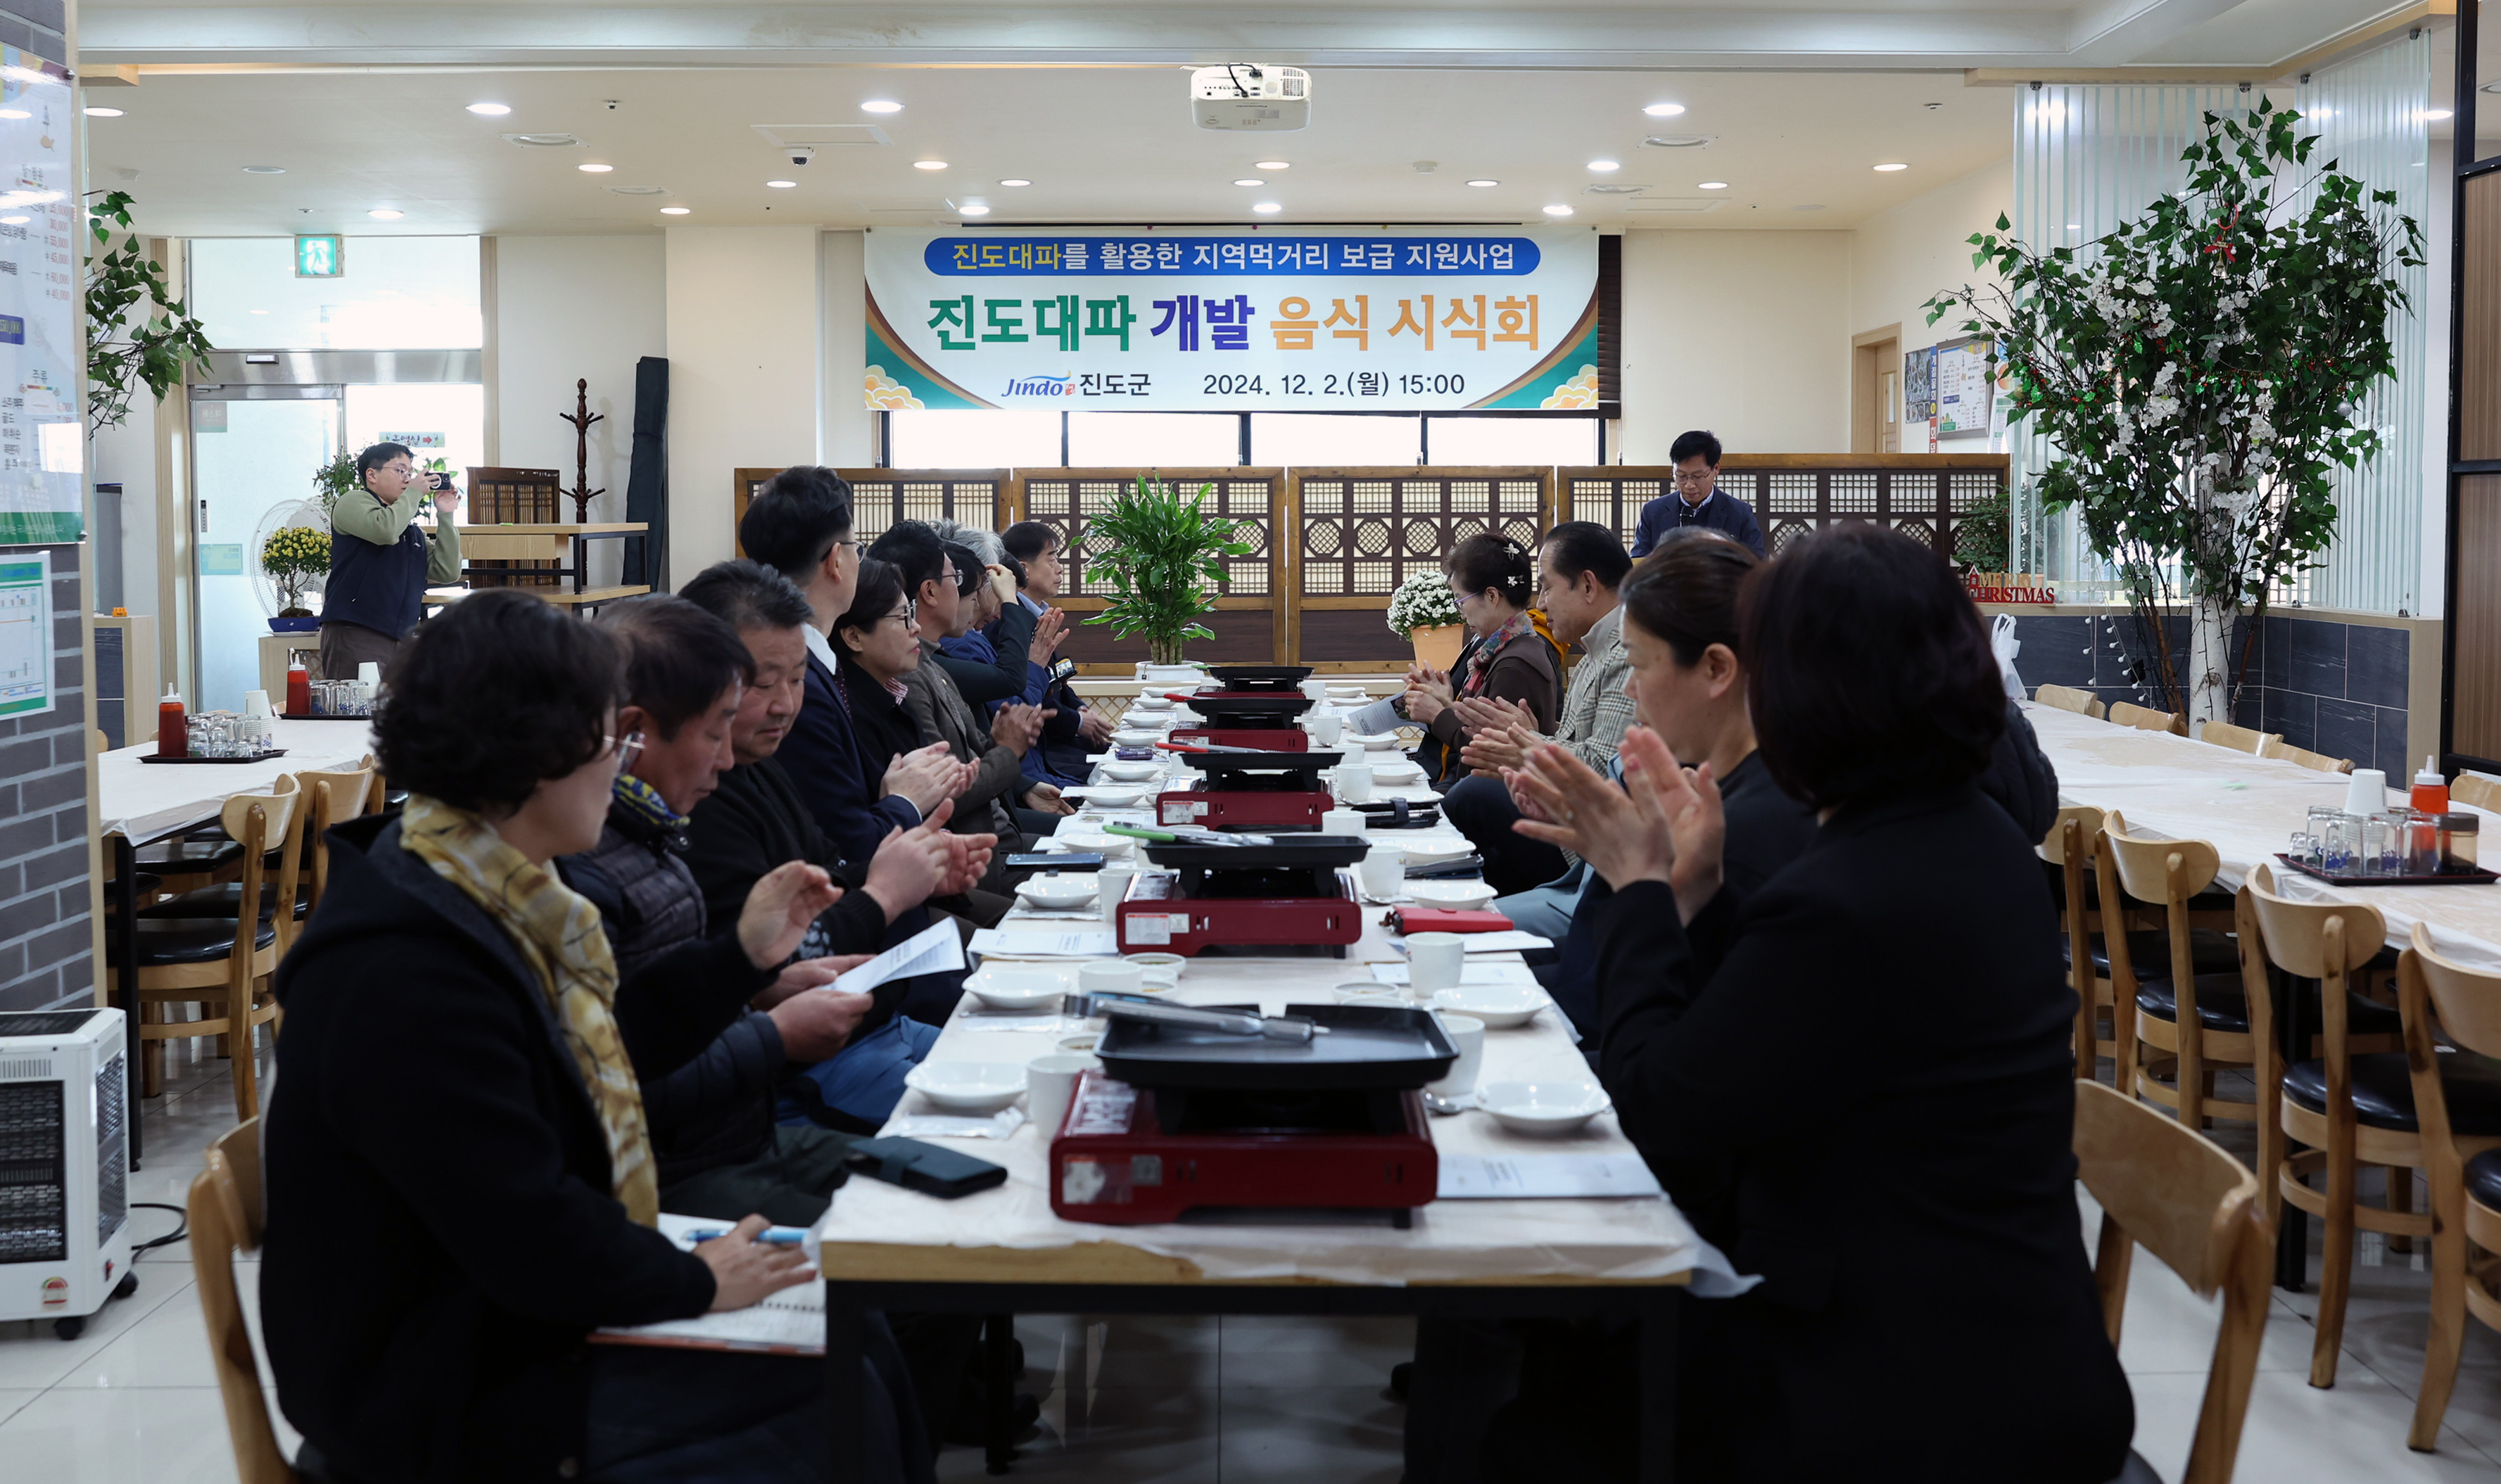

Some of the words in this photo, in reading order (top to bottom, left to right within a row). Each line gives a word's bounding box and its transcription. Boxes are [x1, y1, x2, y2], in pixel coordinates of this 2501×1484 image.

[953, 243, 1089, 270] 진도대파를
[1099, 243, 1183, 270] 활용한
[1193, 243, 1329, 270] 지역먹거리
[1340, 243, 1395, 270] 보급
[1406, 243, 1513, 270] 지원사업
[927, 294, 1137, 351] 진도대파
[1150, 294, 1255, 351] 개발
[1270, 295, 1368, 351] 음식
[1387, 294, 1538, 351] 시식회
[32, 369, 49, 384] 주류
[1079, 372, 1151, 396] 진도군
[1203, 374, 1270, 395] 2024.
[1281, 374, 1313, 395] 12.
[1324, 371, 1389, 398] 2.(월)
[1399, 374, 1465, 395] 15:00
[1001, 379, 1063, 397] Jindo
[1978, 572, 2032, 588] MERRY
[1968, 586, 2055, 603] CHRISTMAS
